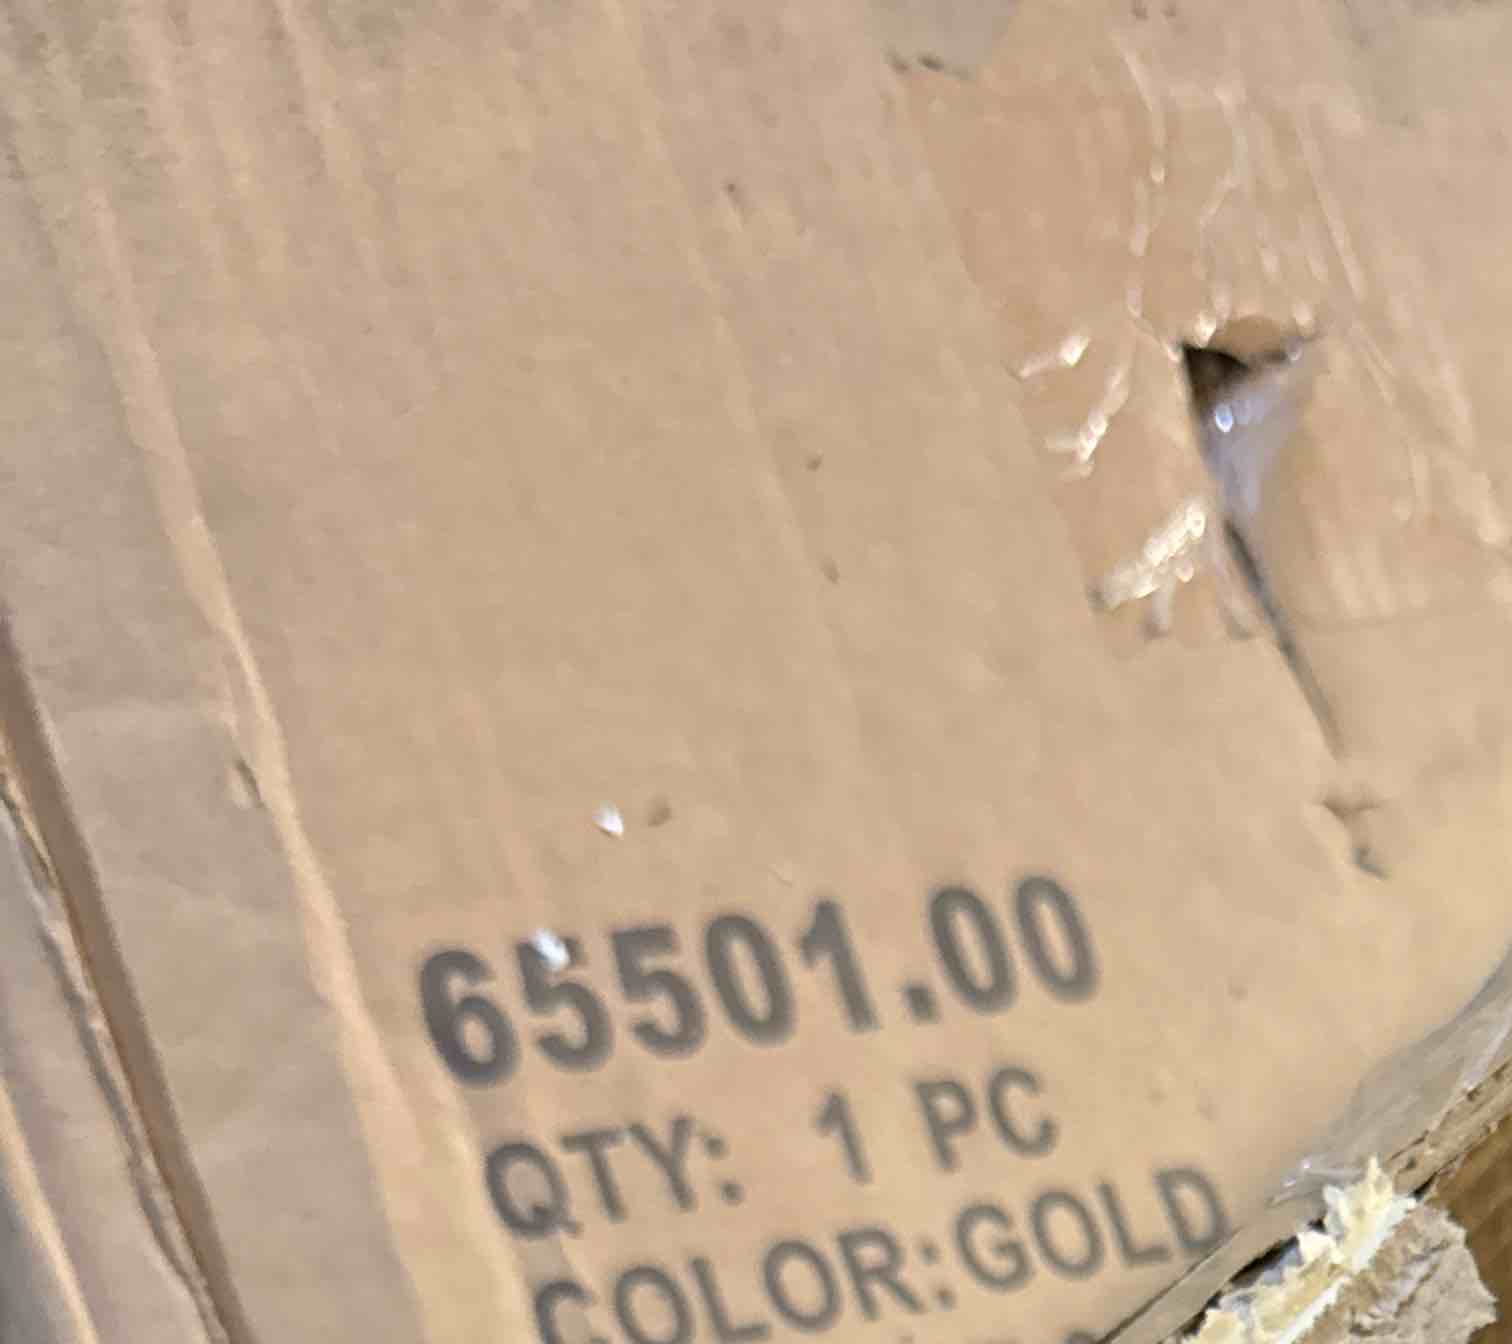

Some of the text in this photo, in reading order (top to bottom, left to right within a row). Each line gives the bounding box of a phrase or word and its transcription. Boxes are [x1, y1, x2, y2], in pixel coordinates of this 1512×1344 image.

[419, 874, 1102, 1087] 65501.00
[484, 1066, 1058, 1240] QTY: 1 PC
